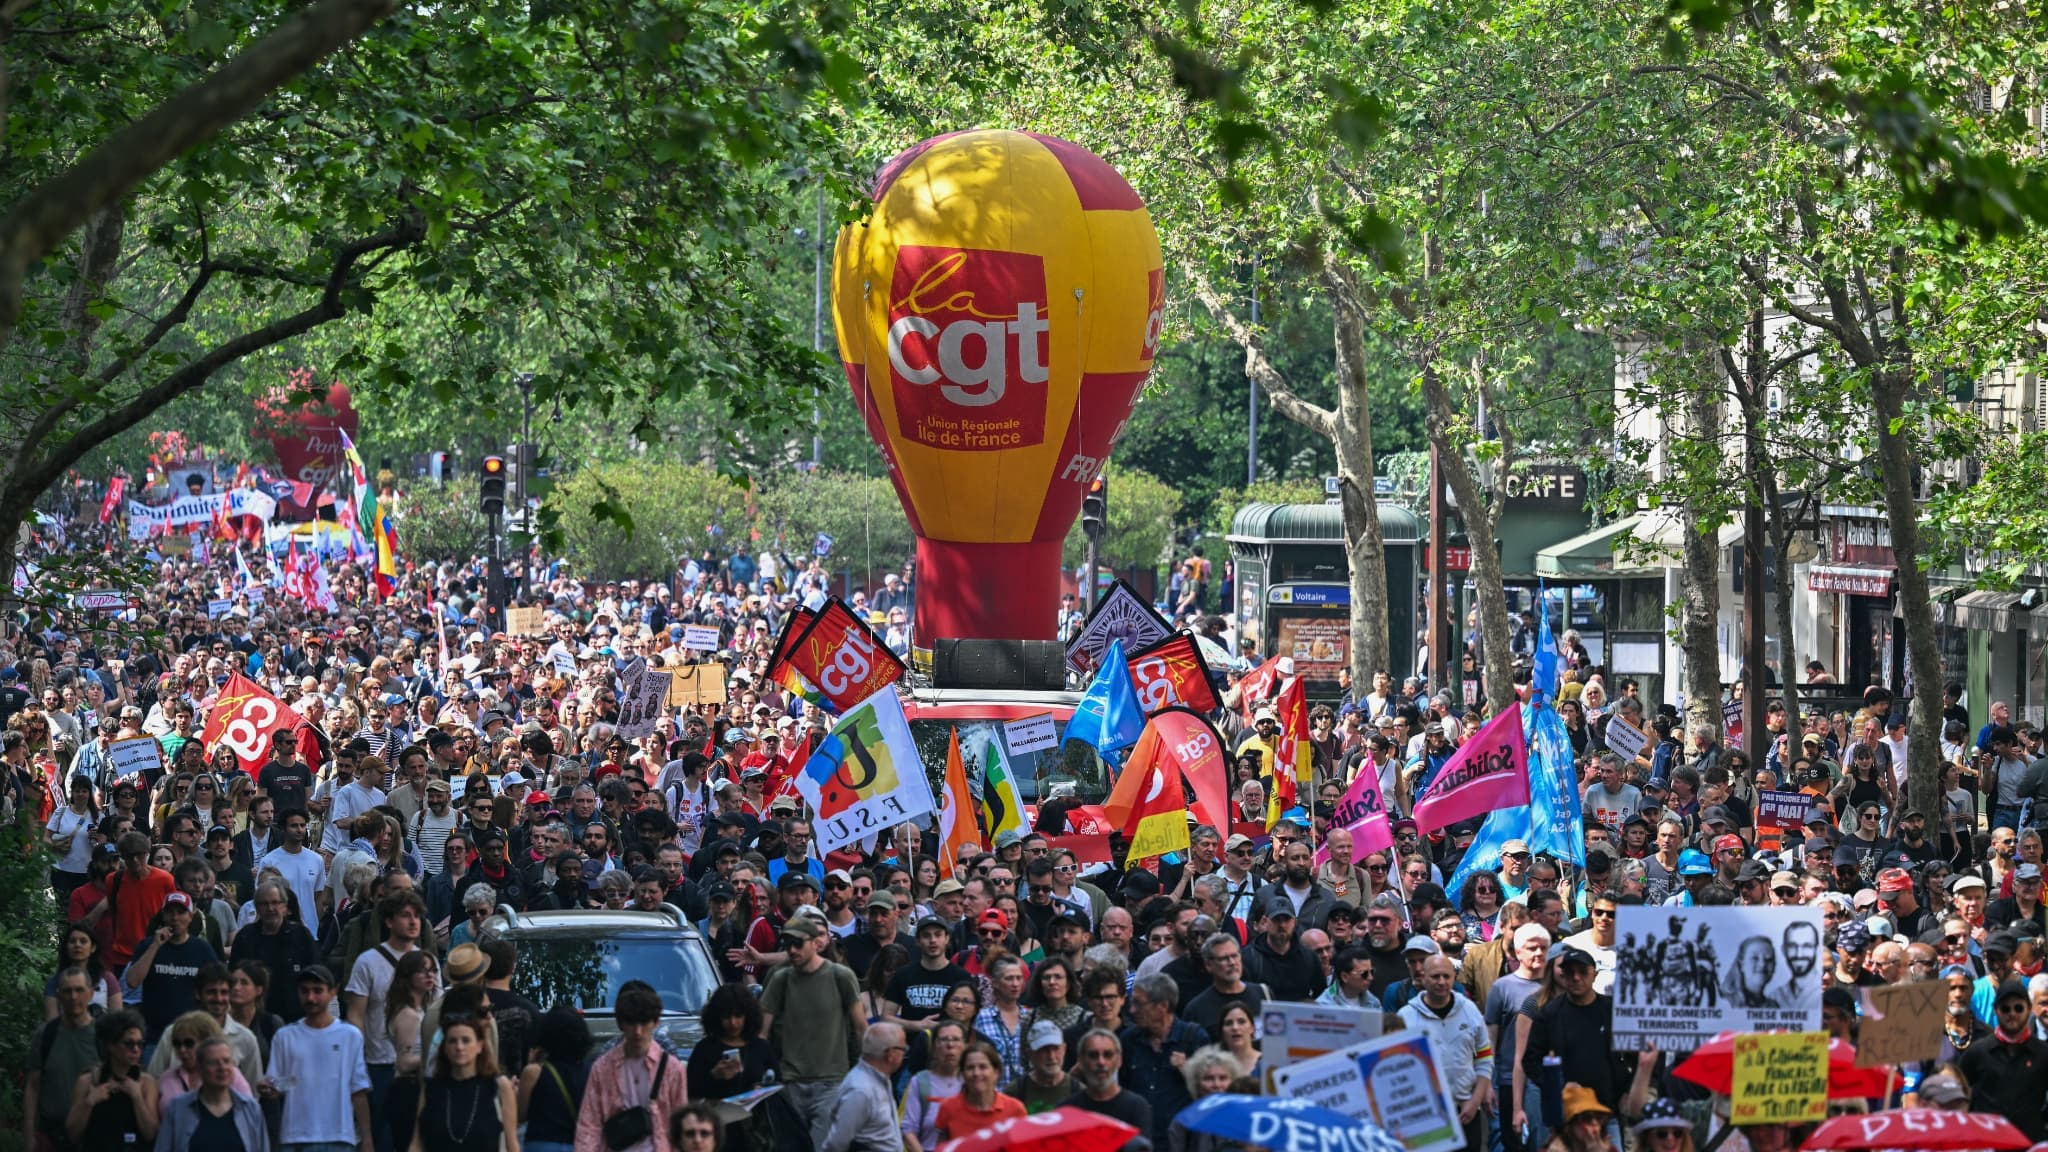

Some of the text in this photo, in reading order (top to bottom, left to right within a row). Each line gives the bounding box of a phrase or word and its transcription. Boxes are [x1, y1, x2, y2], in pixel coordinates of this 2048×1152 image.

[892, 252, 1018, 318] la
[887, 302, 1048, 406] cgt
[927, 415, 1021, 434] Union Régionale
[941, 432, 960, 446] de
[964, 431, 1021, 446] France
[1295, 592, 1327, 601] Voltaire
[820, 628, 877, 696] cgt
[1761, 792, 1775, 801] PAS
[1777, 804, 1802, 819] MAI
[1877, 983, 1940, 1017] TAX
[1615, 1007, 1723, 1019] THESE ARE DOMESTIC
[1747, 1010, 1808, 1020] THESE WERE
[1638, 1020, 1699, 1030] TERRORISTS
[1614, 1034, 1640, 1051] WE
[1644, 1035, 1696, 1051] KNOW
[1290, 1069, 1358, 1098] WORKERS
